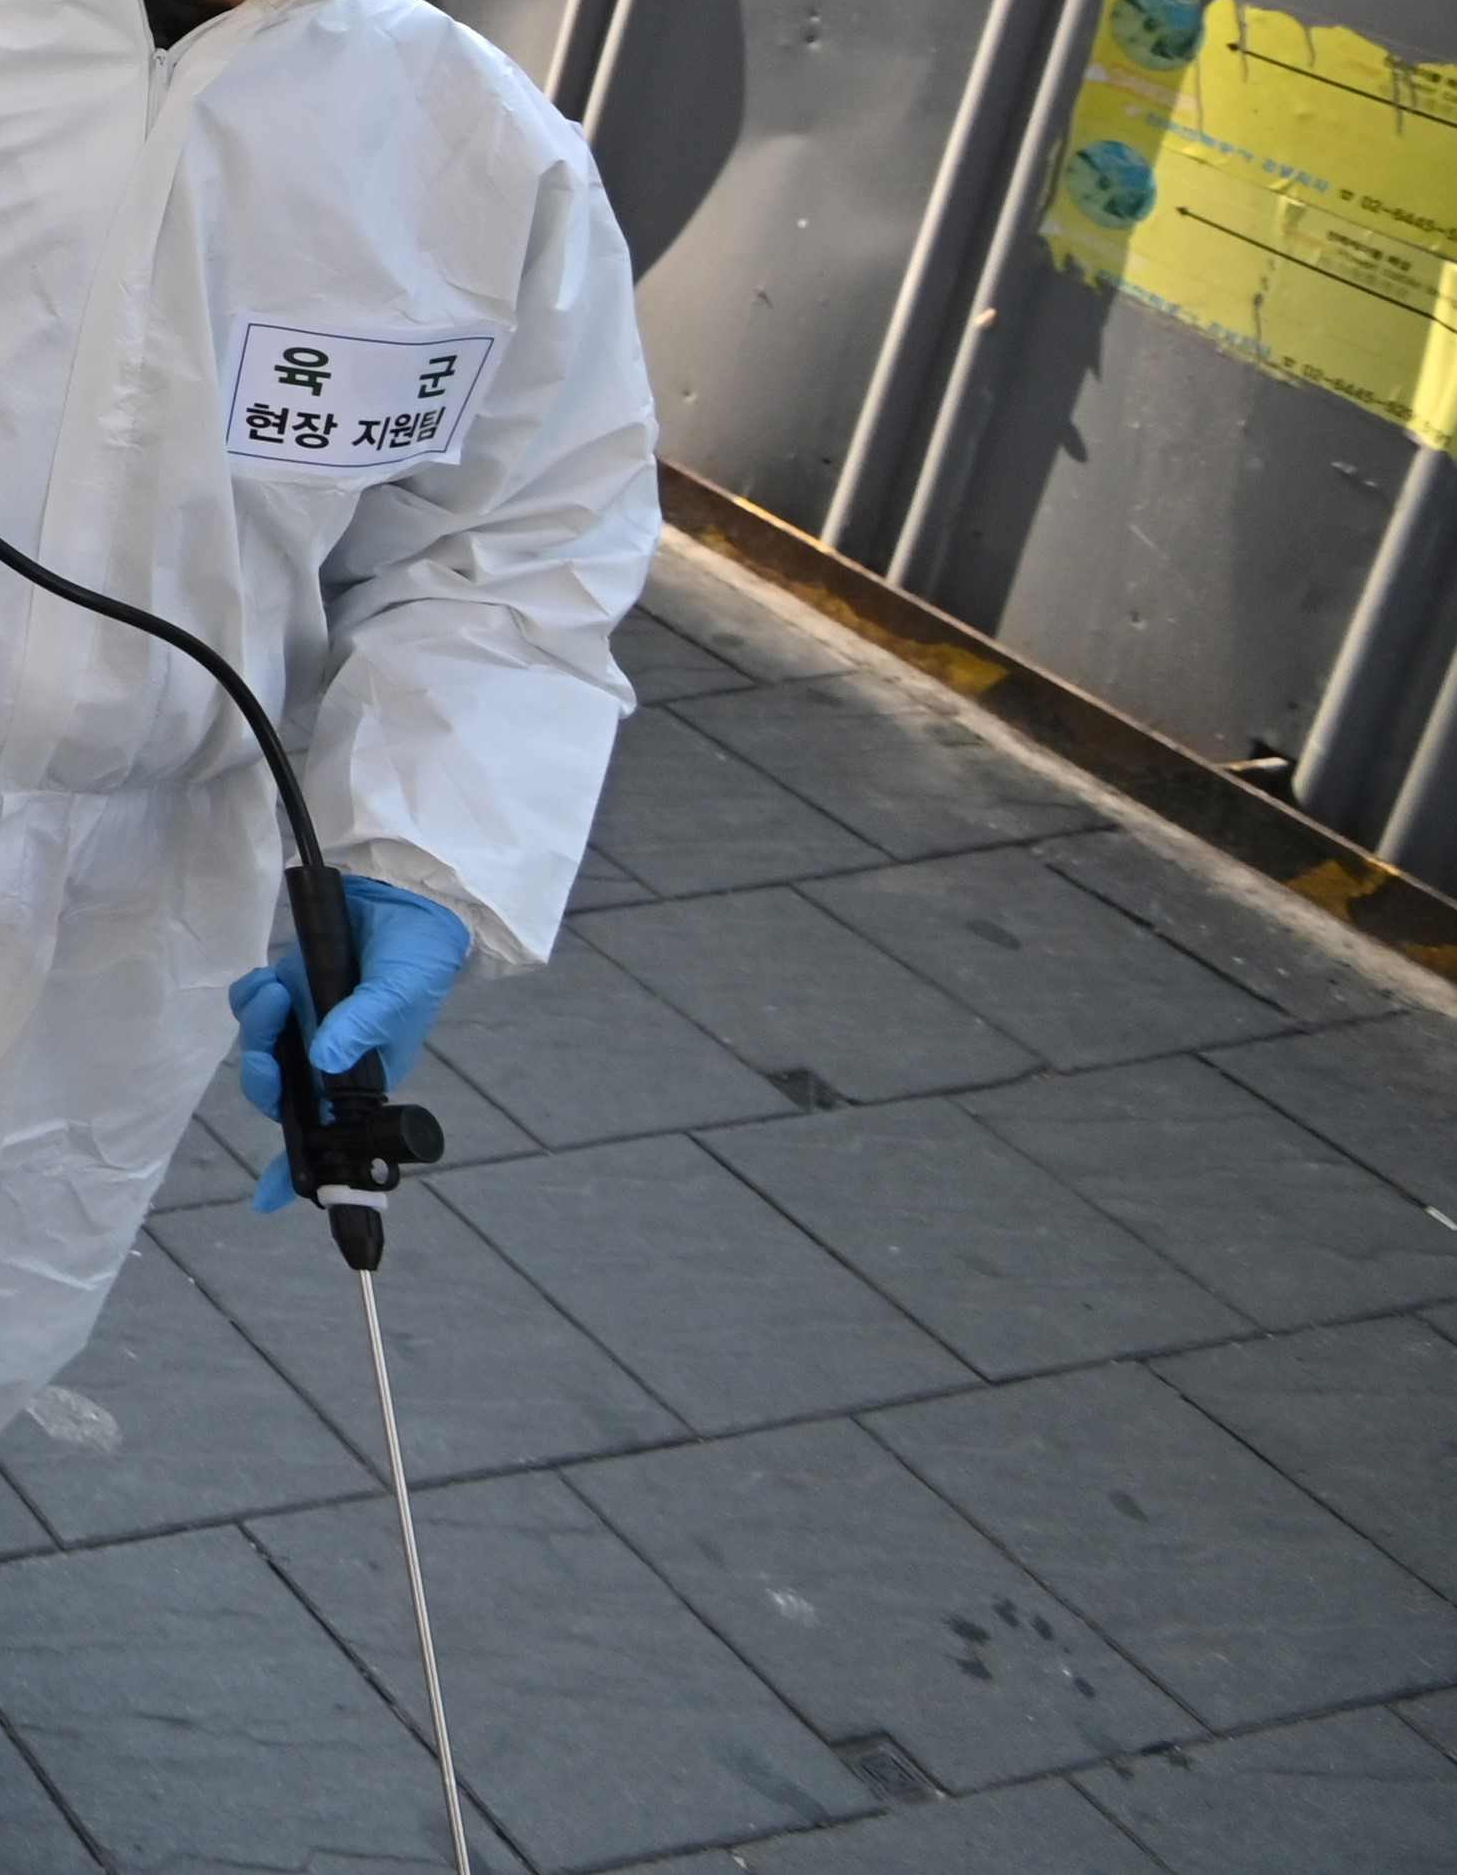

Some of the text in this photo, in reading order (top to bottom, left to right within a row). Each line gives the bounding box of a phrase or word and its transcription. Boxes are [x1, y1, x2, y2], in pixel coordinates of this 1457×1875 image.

[273, 346, 458, 400] 육 군
[245, 402, 447, 451] 현장 지원팀
